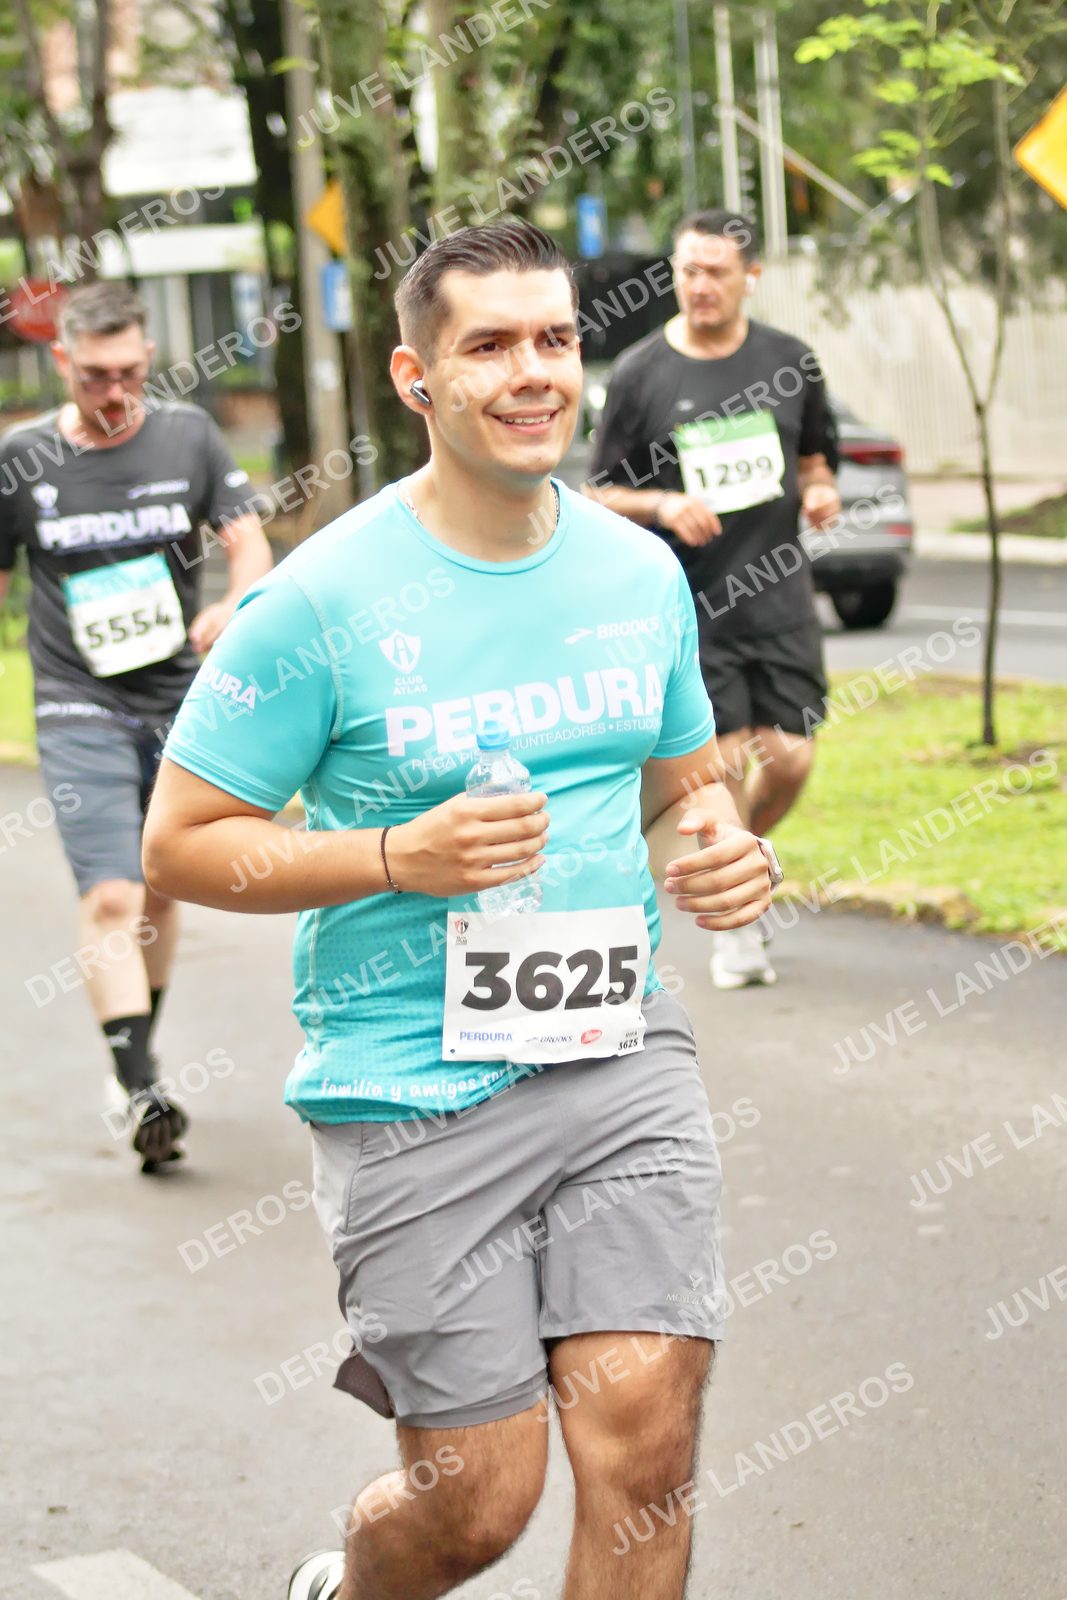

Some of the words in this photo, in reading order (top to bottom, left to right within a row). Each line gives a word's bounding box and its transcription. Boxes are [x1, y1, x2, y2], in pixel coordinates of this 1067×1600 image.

[694, 455, 773, 489] 1299
[35, 502, 192, 550] PERDURA
[84, 603, 171, 650] 5554
[596, 616, 660, 640] BROOKS
[393, 684, 428, 696] ATLAS
[394, 675, 423, 686] CLUB
[385, 663, 663, 757] PERDURA
[412, 754, 457, 770] PEGA
[512, 721, 606, 751] JUNTEADORES
[461, 945, 638, 1012] 3625
[459, 1031, 513, 1042] PERDURA
[320, 1077, 383, 1096] familia
[390, 1085, 403, 1102] y
[409, 1078, 477, 1099] amigos
